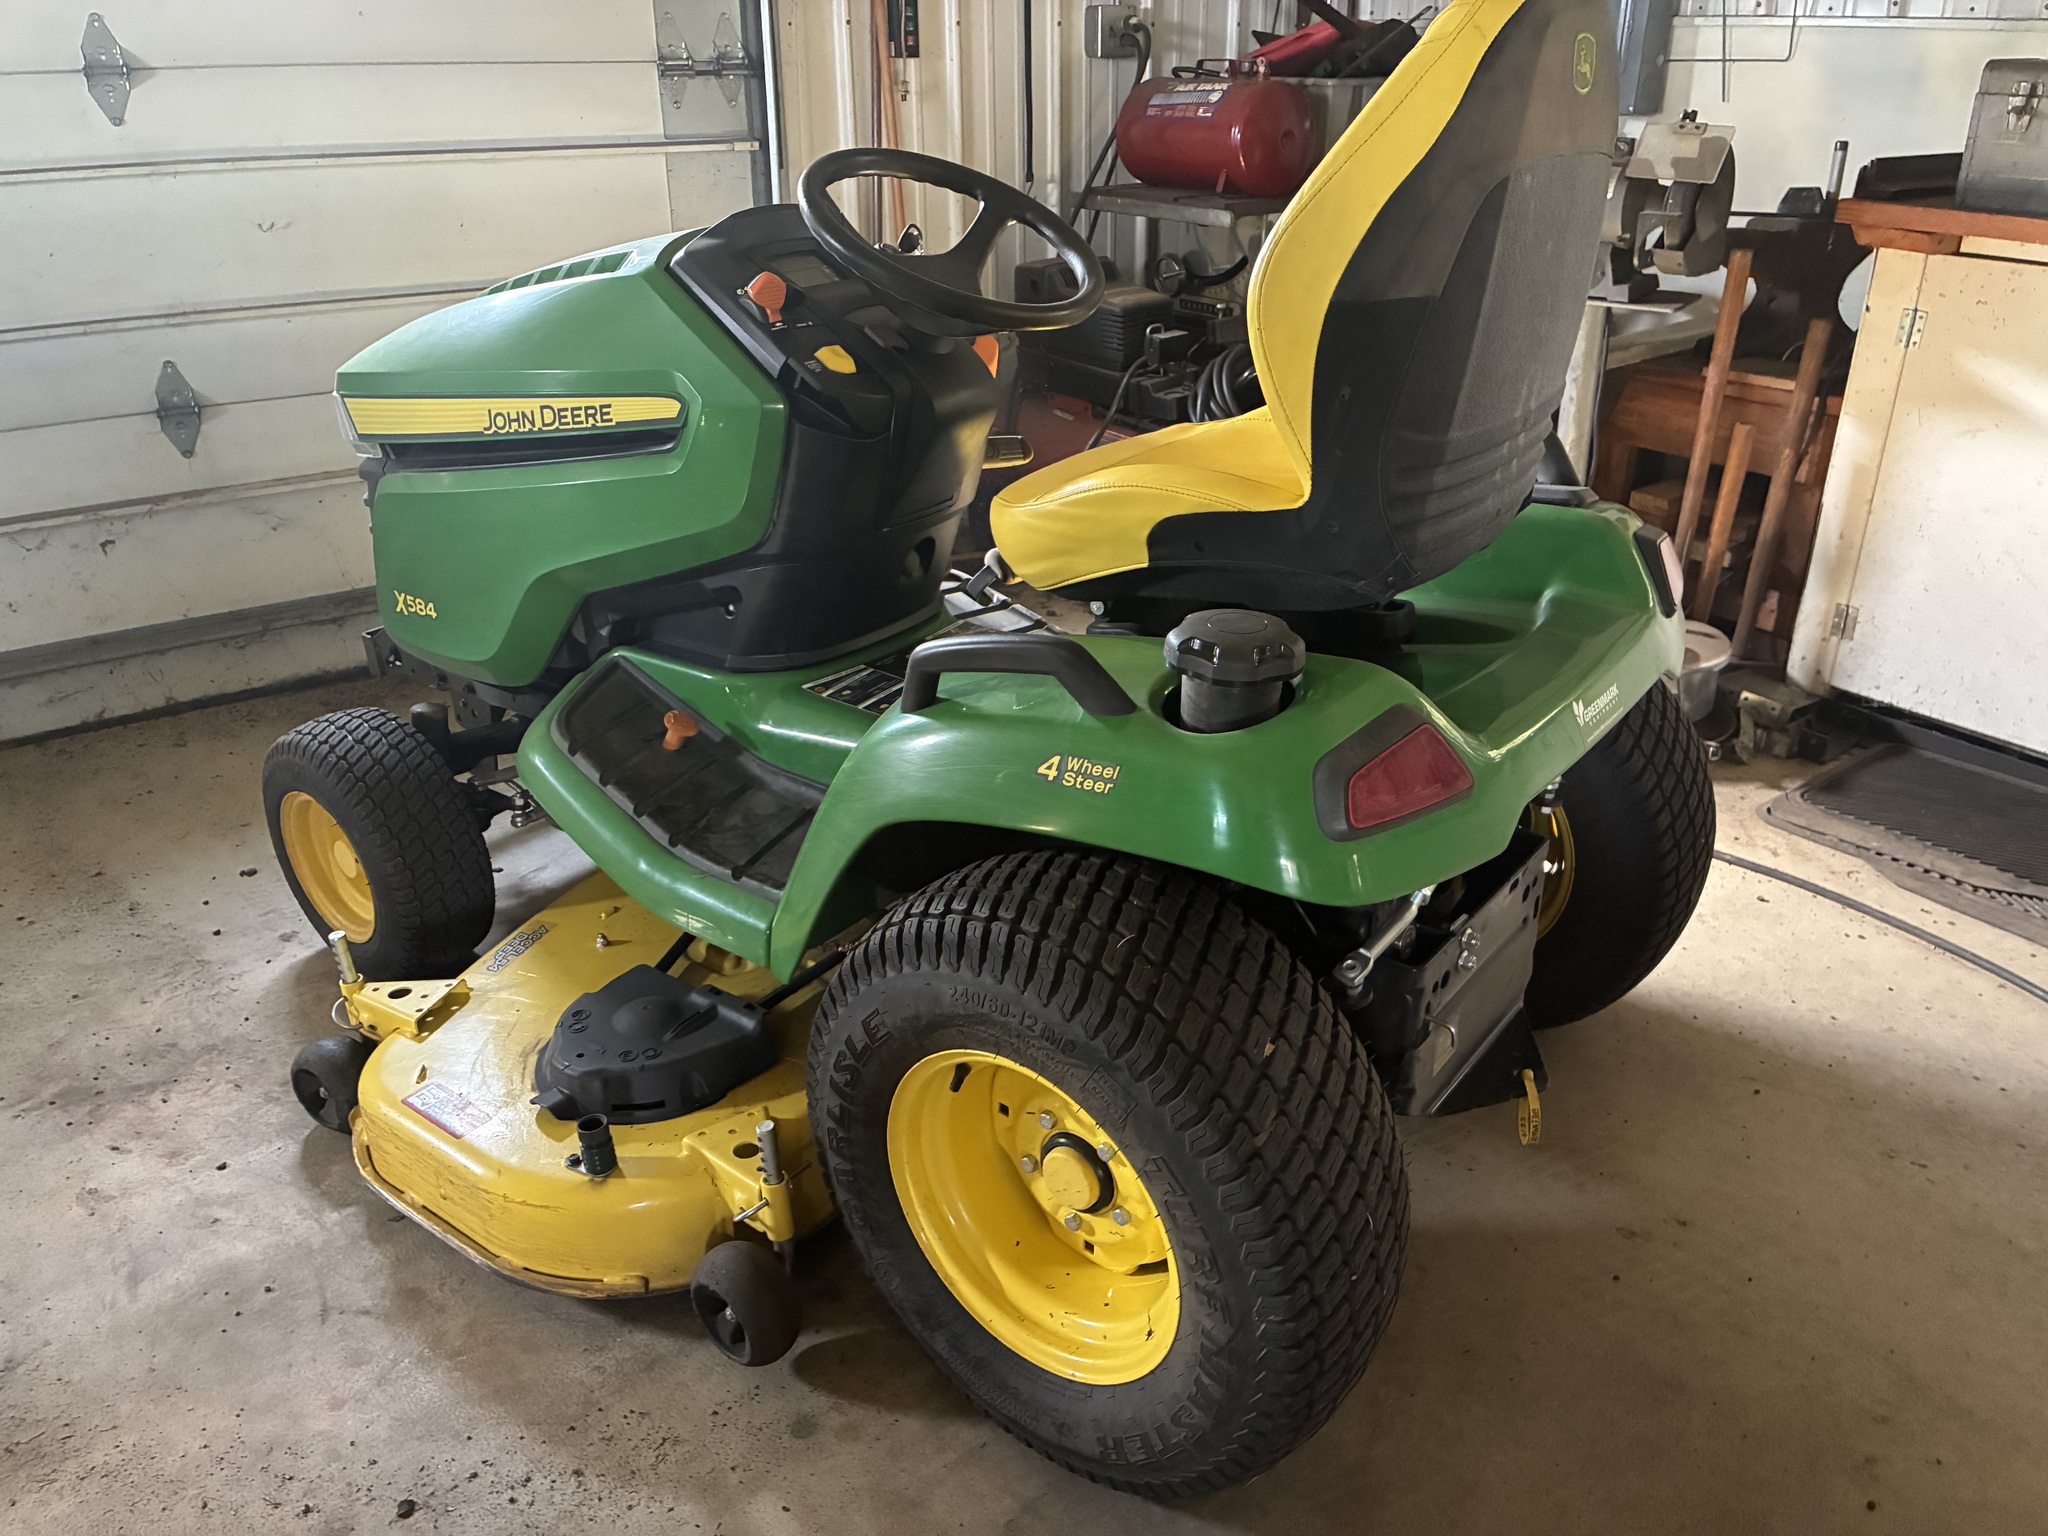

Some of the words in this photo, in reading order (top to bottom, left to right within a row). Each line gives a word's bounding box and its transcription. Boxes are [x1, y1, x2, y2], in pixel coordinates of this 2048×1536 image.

[483, 409, 536, 432] JOHN
[540, 404, 613, 427] DEERE
[394, 590, 437, 619] X584
[1584, 682, 1619, 722] GREENMARK
[1037, 755, 1061, 781] 4
[1067, 756, 1120, 780] Wheel
[1062, 771, 1114, 794] Steer
[495, 932, 528, 960] DEEP
[506, 925, 549, 957] ACCEL
